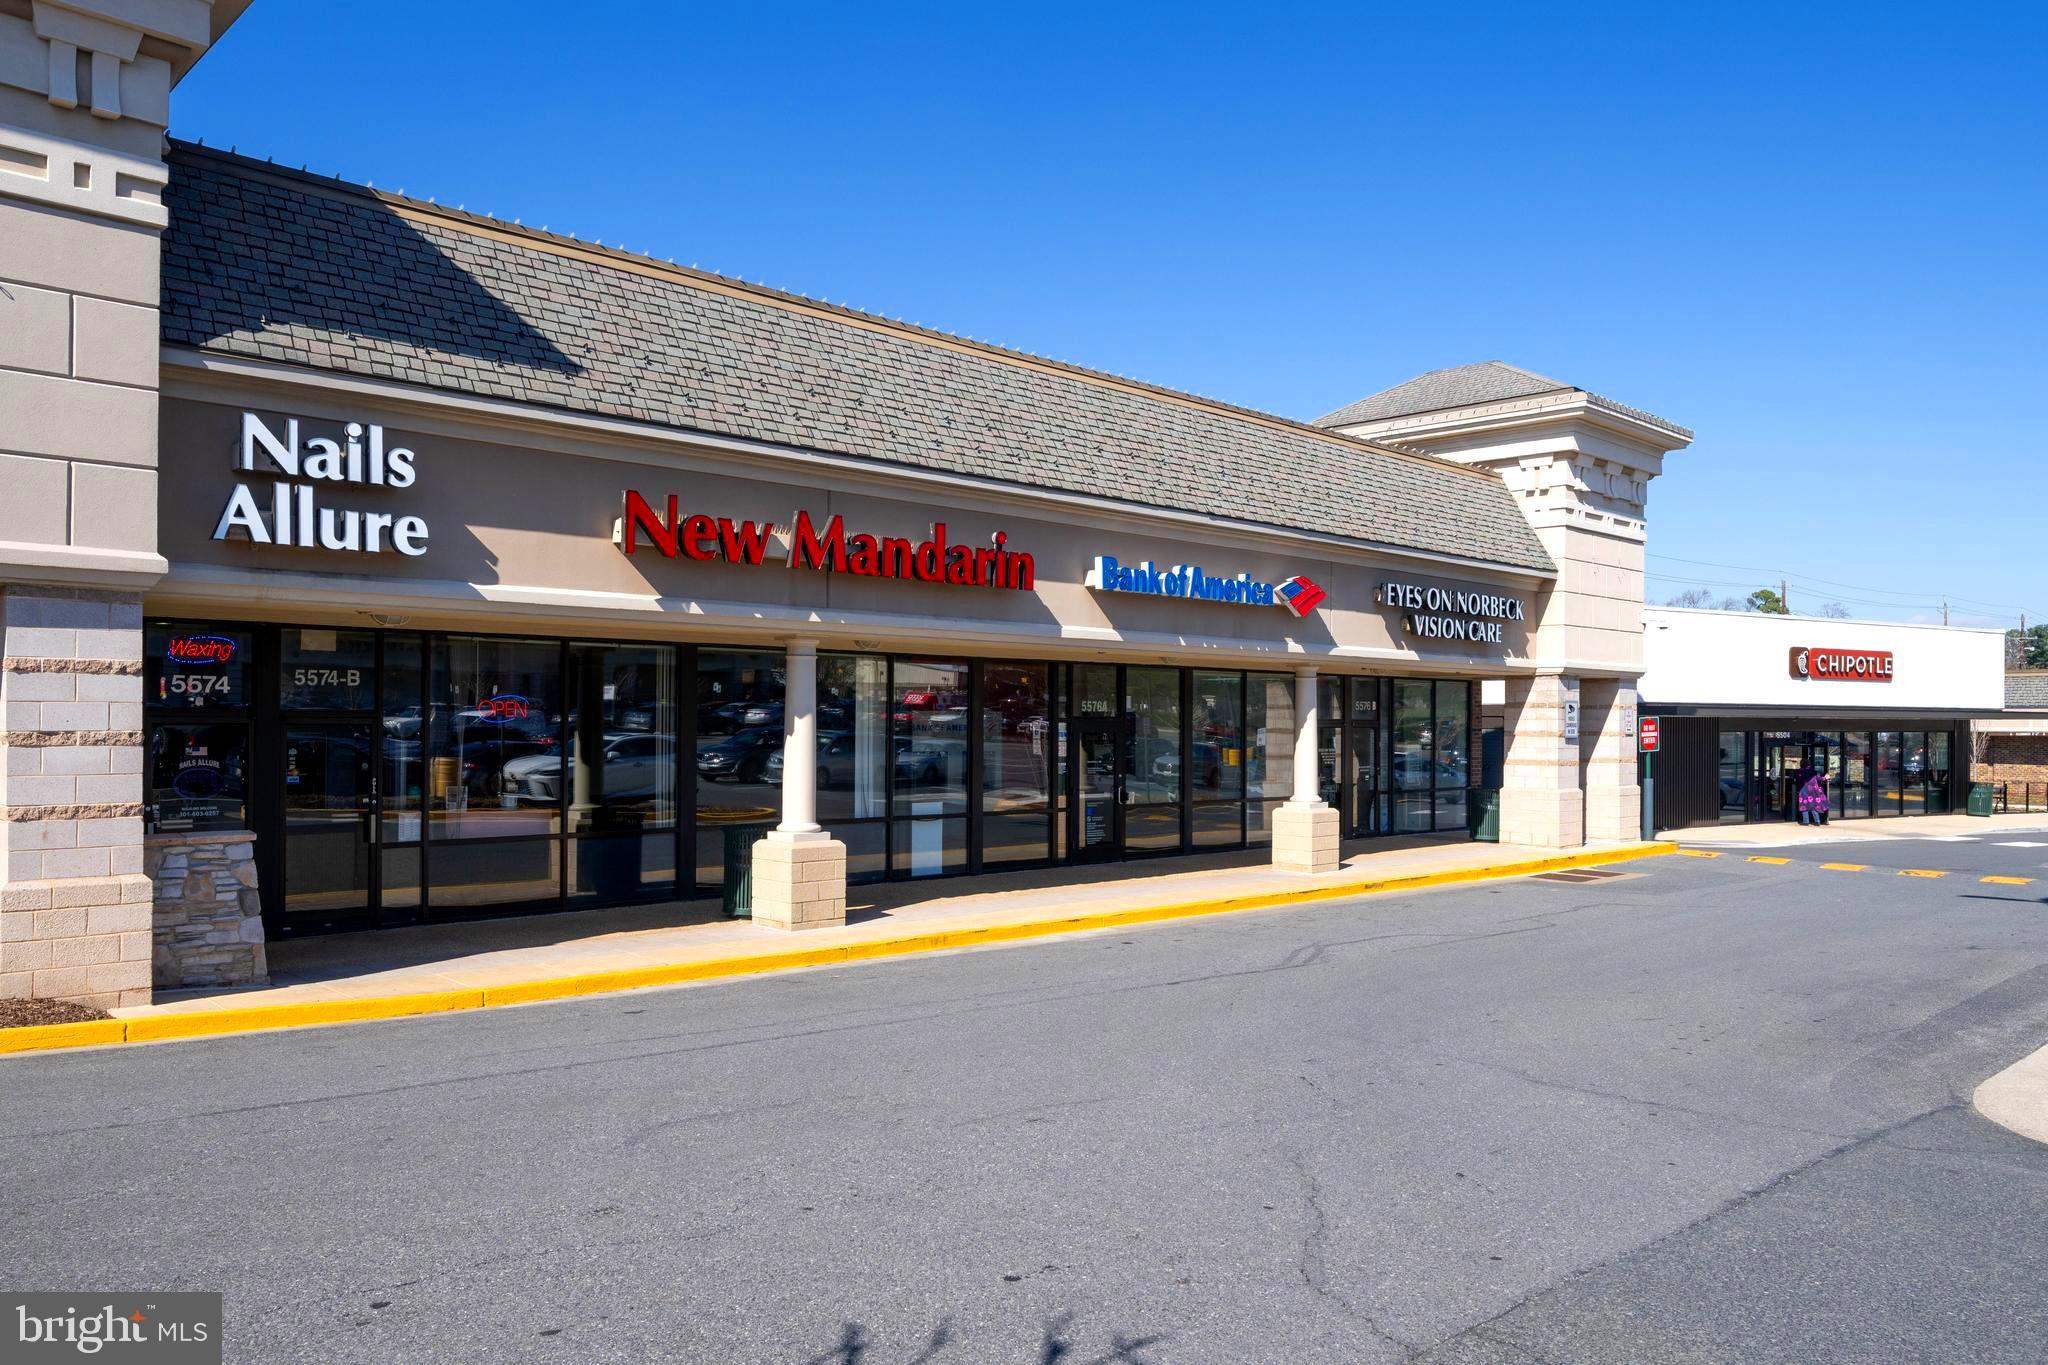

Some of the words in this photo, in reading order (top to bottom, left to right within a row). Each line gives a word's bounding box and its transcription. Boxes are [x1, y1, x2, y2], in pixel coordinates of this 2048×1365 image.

[240, 411, 416, 488] Nails
[212, 482, 429, 556] Allure
[622, 489, 773, 566] New
[788, 510, 1035, 591] Mandarin
[1098, 556, 1162, 595] Bank
[1164, 564, 1187, 597] of
[1189, 566, 1274, 606] America
[1387, 583, 1422, 609] EYES
[1427, 587, 1452, 612] ON
[1457, 591, 1525, 621] NORBECK
[1414, 614, 1465, 640] VISION
[1469, 620, 1503, 643] CARE
[170, 639, 233, 661] Waxing
[1817, 654, 1892, 674] CHIPOTLE
[294, 669, 361, 687] 5574-B
[477, 699, 528, 719] OPEN
[1081, 700, 1108, 712] 5576A
[1355, 701, 1371, 711] 5576
[197, 758, 220, 769] ALLURE
